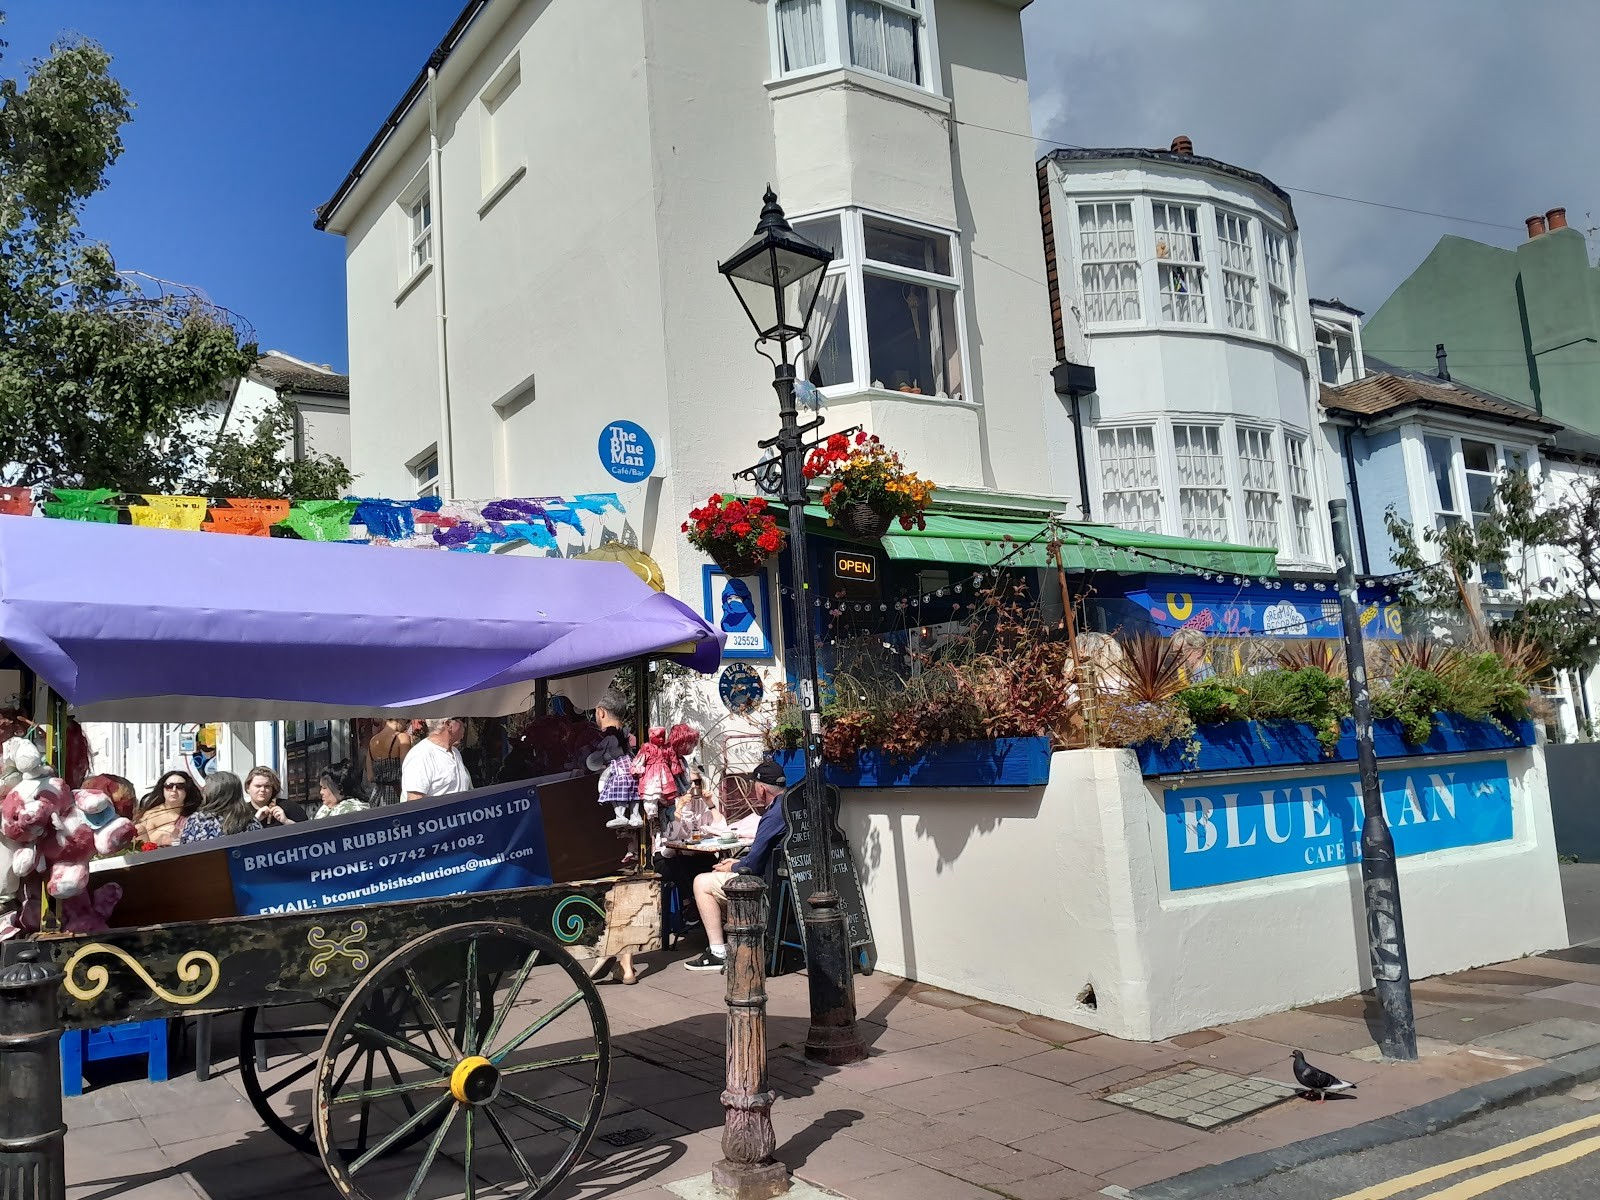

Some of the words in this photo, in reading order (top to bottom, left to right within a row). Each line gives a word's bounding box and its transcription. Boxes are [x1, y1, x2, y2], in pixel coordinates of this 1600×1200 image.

[609, 426, 637, 442] The
[610, 437, 644, 455] Blue
[610, 449, 645, 467] Man
[838, 559, 871, 574] OPEN
[733, 635, 759, 646] 325529
[1180, 784, 1332, 854] BLUE
[244, 840, 337, 872] BRIGHTON
[342, 825, 413, 852] RUBBISH
[417, 804, 503, 836] SOLUTIONS
[506, 798, 531, 815] LTD
[310, 860, 374, 883] PHONE:
[378, 847, 427, 867] 07742
[431, 833, 485, 855] 741082
[1304, 838, 1346, 865] CAFÉ
[322, 847, 534, 906] btonrubbishsolutions@mail.com
